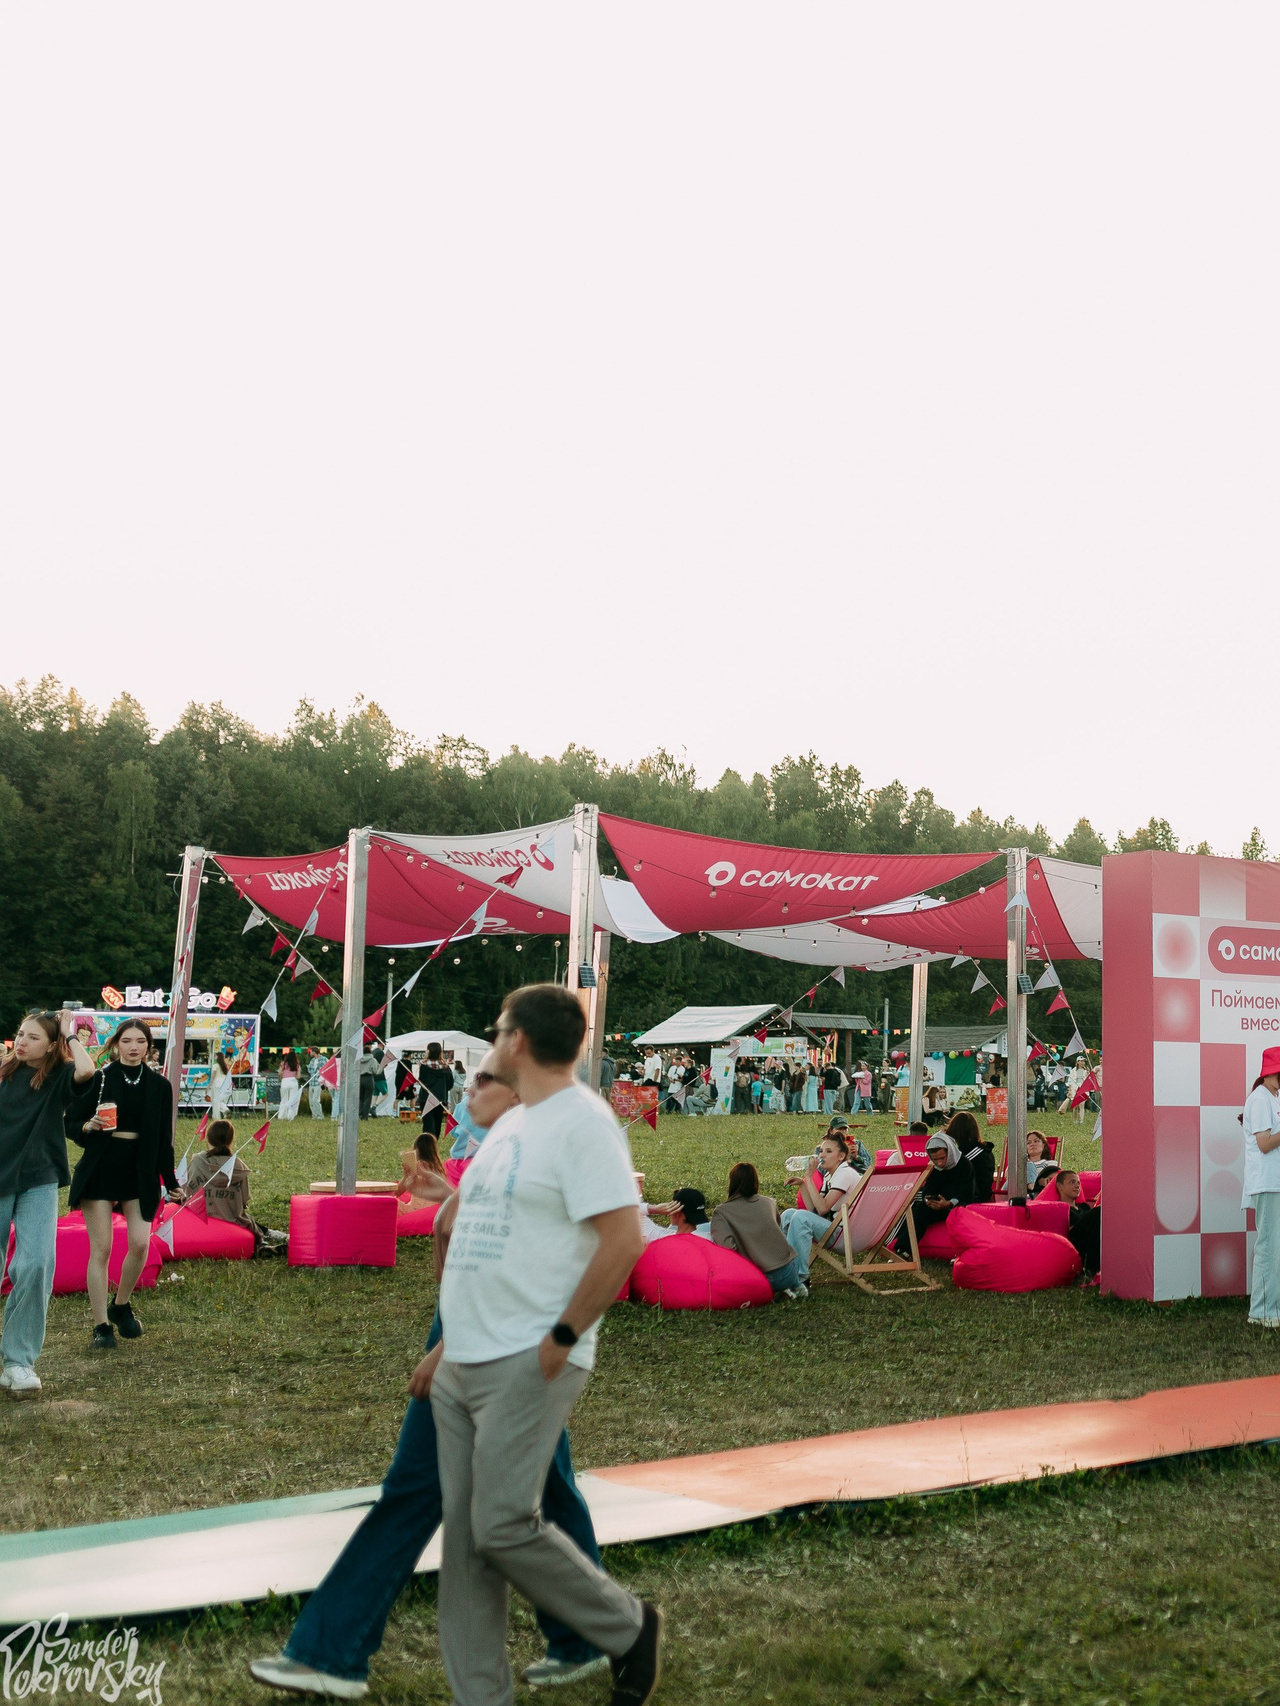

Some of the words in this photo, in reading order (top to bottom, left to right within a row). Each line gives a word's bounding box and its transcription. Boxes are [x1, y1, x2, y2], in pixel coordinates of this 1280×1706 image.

[740, 870, 880, 891] самокат
[125, 985, 165, 1008] Eat
[187, 987, 217, 1009] Go
